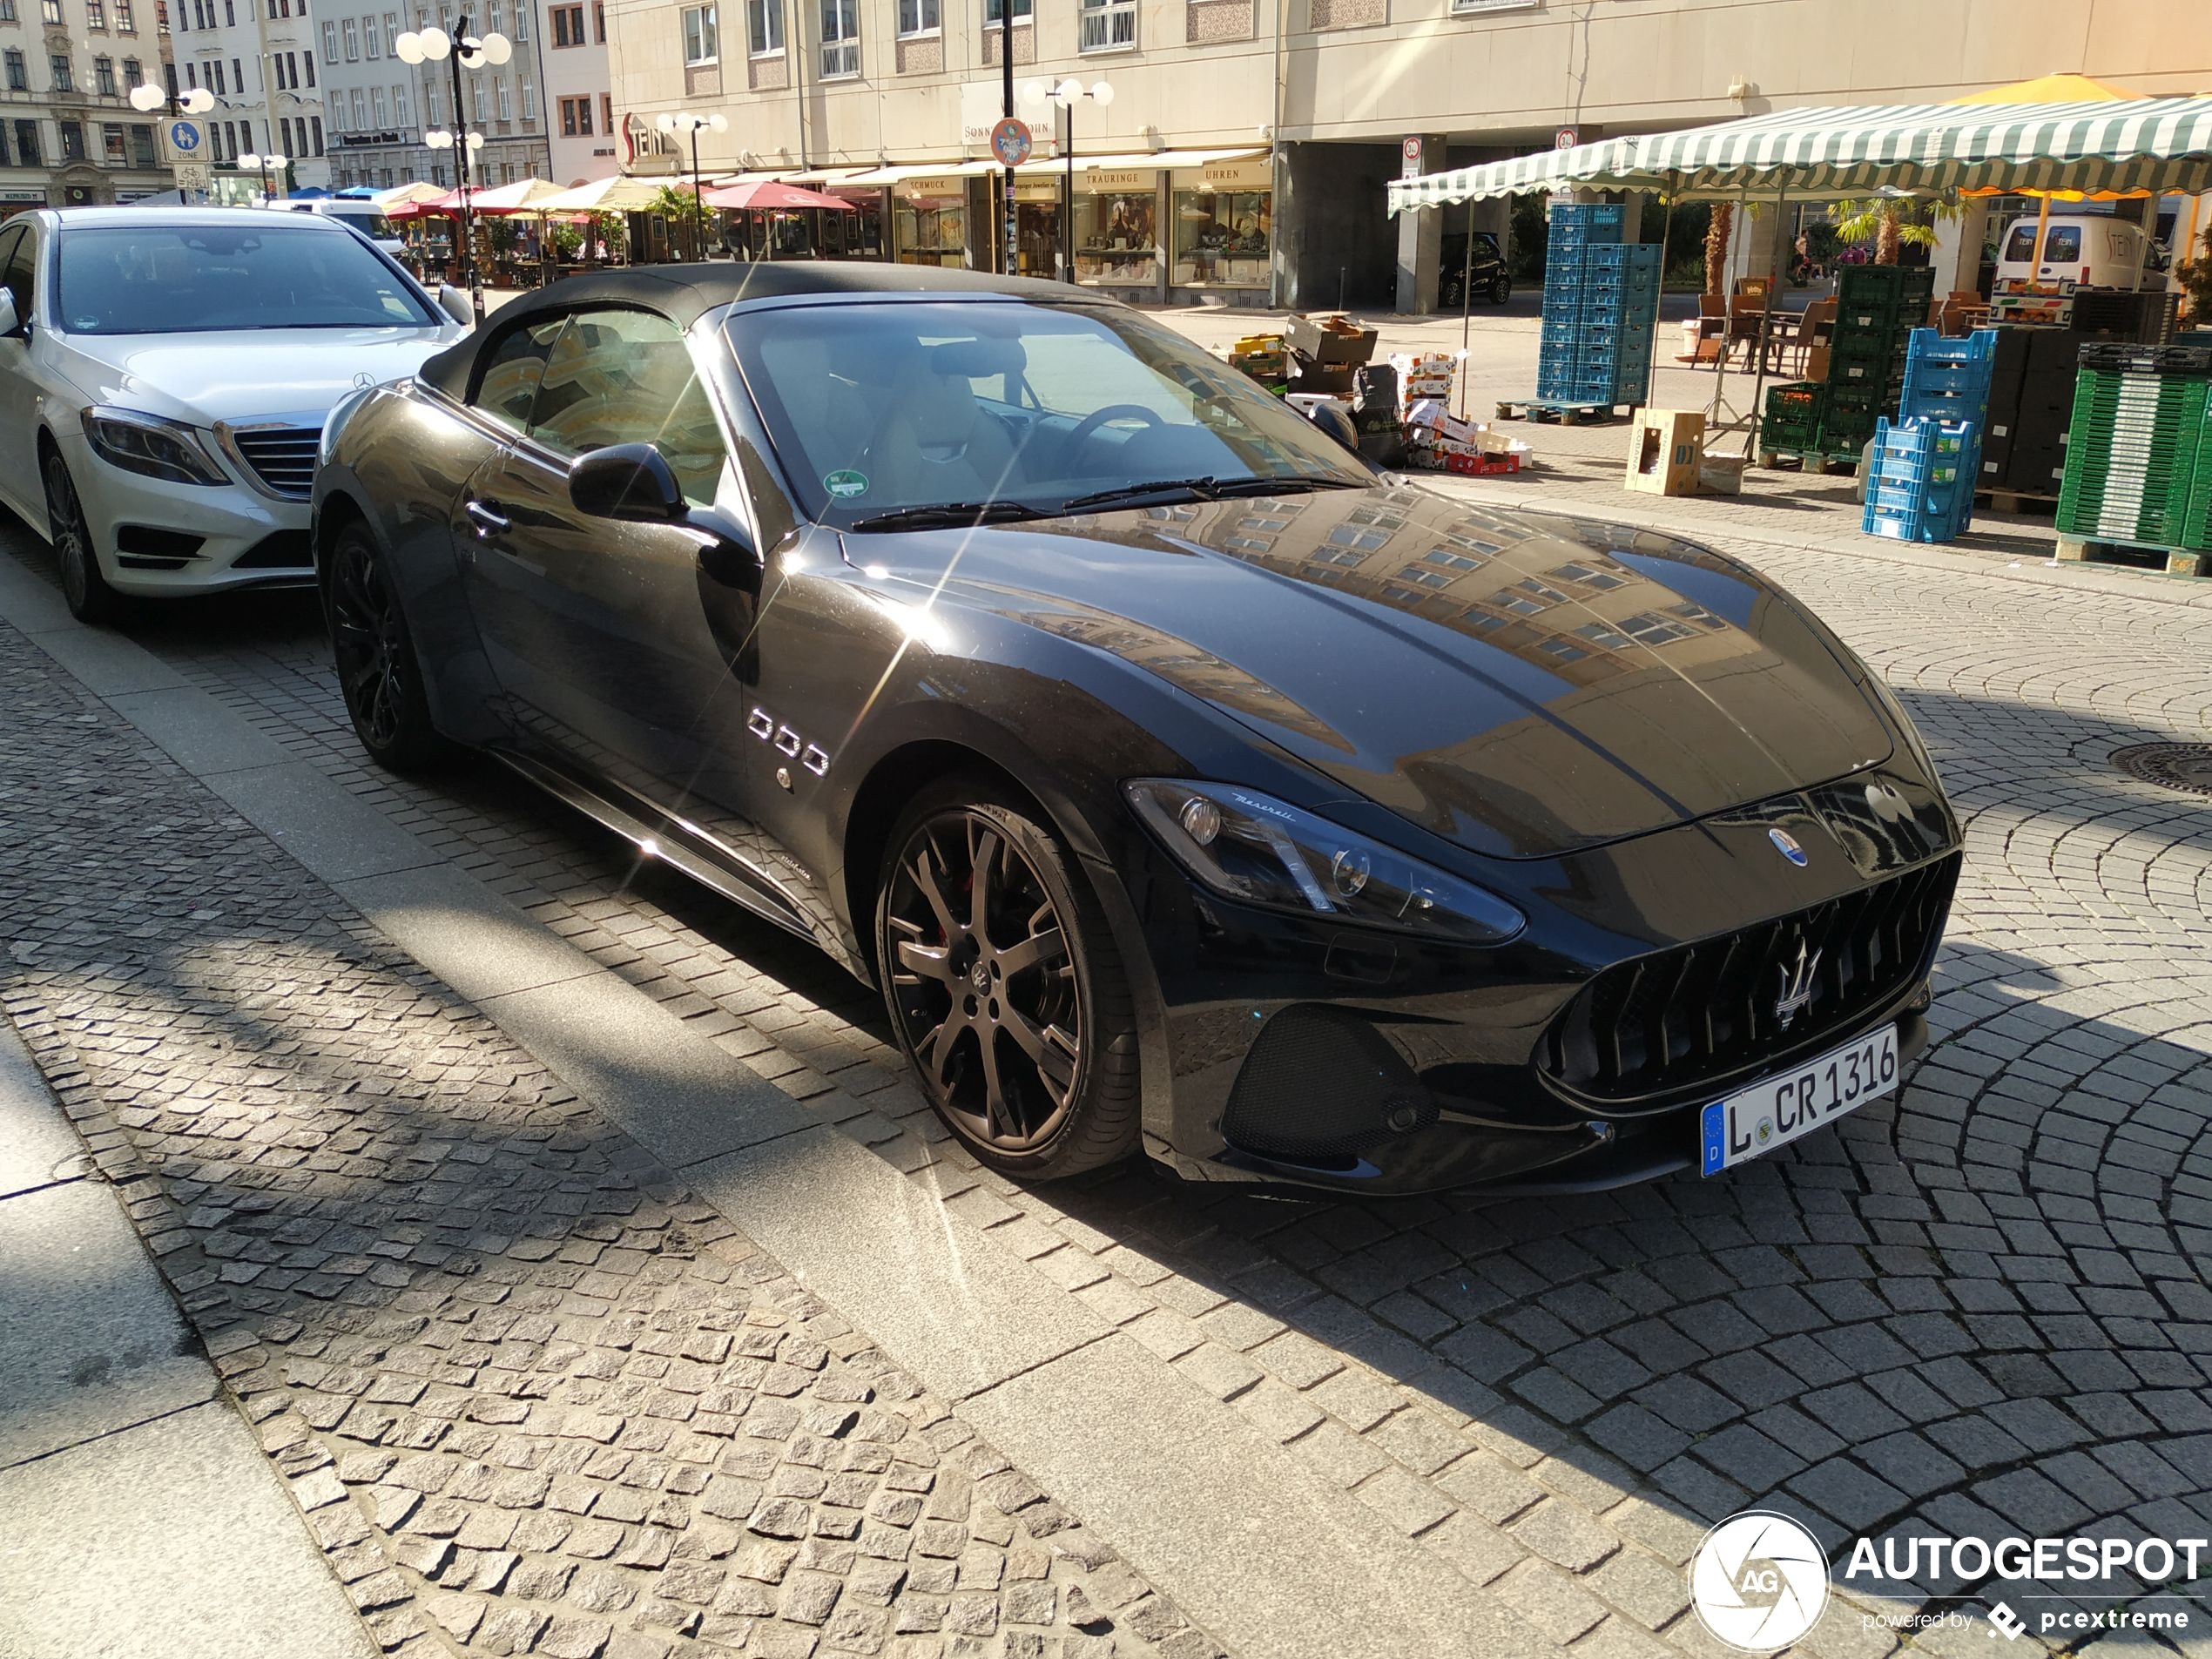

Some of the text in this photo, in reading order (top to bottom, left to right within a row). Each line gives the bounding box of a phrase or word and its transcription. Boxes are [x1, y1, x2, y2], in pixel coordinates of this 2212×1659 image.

[1087, 173, 1138, 185] TRAURINGE
[1205, 169, 1239, 179] UHREN
[910, 180, 945, 190] SCHMUCK
[1231, 792, 1297, 822] Maserati
[1730, 1035, 1895, 1157] L CR 1316
[1710, 1145, 1718, 1162] D
